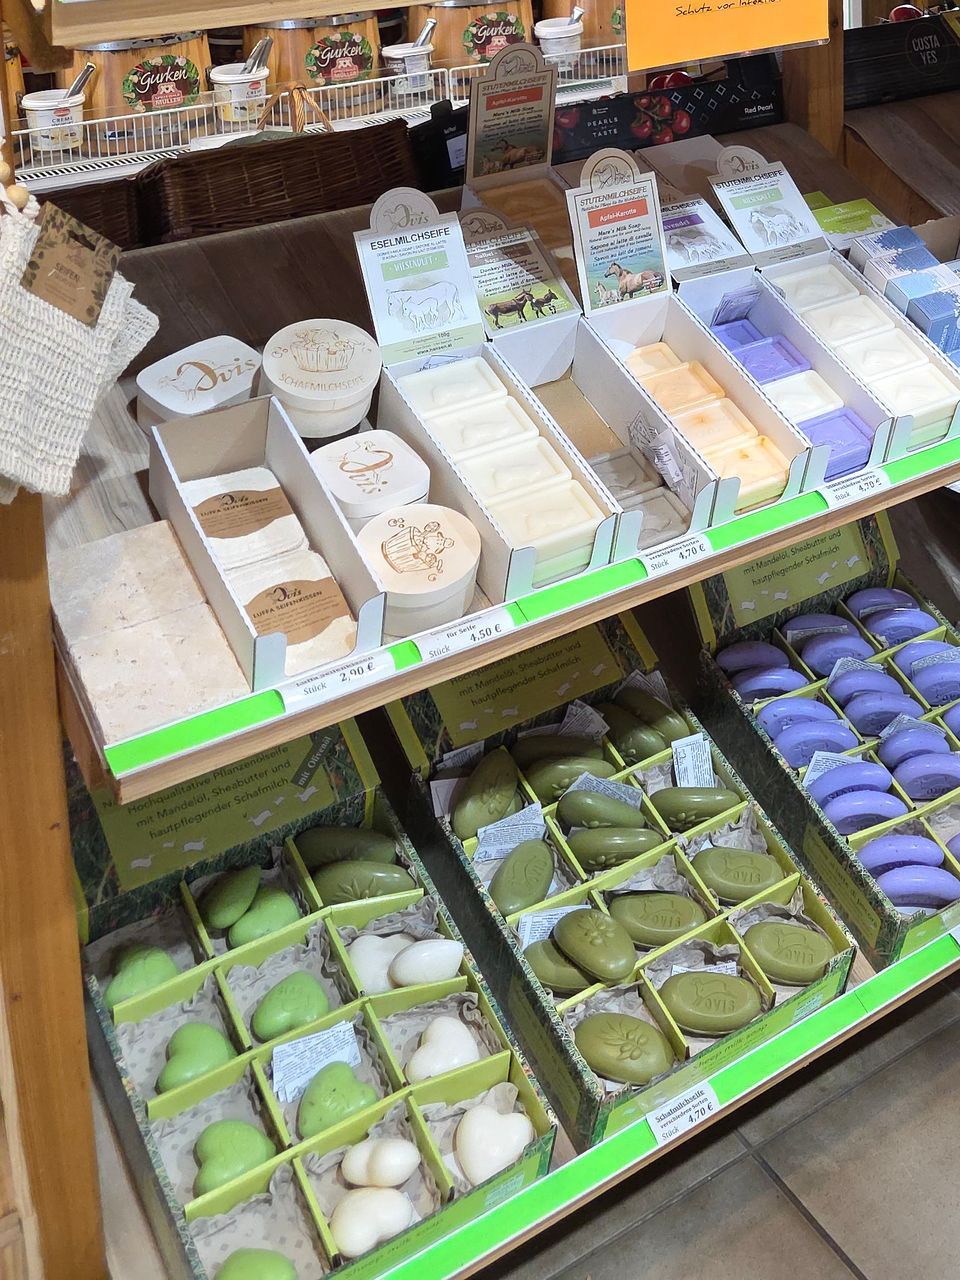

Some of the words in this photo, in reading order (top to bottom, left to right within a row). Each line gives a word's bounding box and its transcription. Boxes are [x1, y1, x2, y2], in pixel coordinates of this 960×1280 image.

[675, 5, 712, 17] Schutz
[717, 2, 735, 10] vor
[478, 23, 518, 44] Gurken
[320, 43, 365, 67] Gurken
[920, 50, 938, 64] YES
[139, 66, 189, 94] Gurken
[744, 105, 757, 114] Red
[758, 103, 774, 113] Pearl
[587, 116, 619, 128] PEARLS
[592, 128, 619, 138] TASTE
[715, 169, 785, 190] STUTENMILCHSEIFE
[580, 186, 648, 207] STUTENMILCHSEIFE
[599, 208, 637, 222] Apfel-Karotte
[370, 227, 451, 251] ESELMILCHSEIFE
[598, 227, 614, 237] Mare's
[615, 225, 627, 234] Milk
[628, 223, 642, 232] Soap
[55, 262, 81, 283] SEIFEN
[177, 357, 256, 391] Ovis
[278, 372, 366, 392] SCHAFMILCHSEIFE
[835, 491, 850, 501] Stück
[858, 480, 874, 492] 4,70
[876, 478, 882, 486] €
[200, 508, 221, 517] LUFFA
[223, 497, 269, 513] SEIFENKISSEN
[649, 544, 681, 561] verschiedene
[682, 538, 699, 549] Sorten
[650, 560, 669, 571] Stück
[678, 546, 698, 561] 4,70
[699, 543, 706, 552] €
[743, 564, 755, 575] mit
[756, 553, 788, 570] Mandelöl,
[791, 535, 827, 556] Sheabutter
[829, 530, 841, 540] und
[752, 560, 803, 586] hautpflegender
[805, 545, 840, 565] Schafmilch
[253, 608, 275, 619] LUFFA
[276, 591, 323, 611] SEIFENKISSEN
[273, 586, 302, 602] Ovis
[429, 645, 450, 658] Stück
[470, 627, 492, 643] 4,50
[494, 624, 502, 633] €
[446, 630, 457, 639] für
[459, 623, 477, 634] Seife
[303, 681, 327, 696] Stück
[339, 667, 364, 683] 2,90
[367, 662, 375, 671] €
[459, 686, 474, 697] mit
[475, 669, 518, 690] Mandelöl,
[519, 649, 563, 671] Sheabutter
[565, 642, 582, 653] und
[471, 675, 536, 707] hautpflegender
[537, 656, 582, 680] Schafmilch
[299, 769, 309, 786] mit
[308, 735, 331, 769] Olivenöl
[127, 778, 211, 815] Hochqualitative
[213, 746, 289, 781] Pflanzenölseife
[136, 815, 155, 828] mit
[157, 795, 209, 820] Mandelöl,
[211, 769, 269, 797] Sheabutter
[271, 760, 291, 774] und
[150, 801, 232, 839] hautpflegender
[235, 777, 289, 805] Schafmilch
[733, 870, 761, 883] OVIS
[786, 947, 814, 964] OVIS
[704, 997, 735, 1010] OVIS
[655, 1089, 705, 1124] Schafmilchseife
[660, 1109, 691, 1129] verschiedene
[692, 1097, 709, 1110] Sorten
[661, 1126, 680, 1141] Stück
[687, 1107, 706, 1125] 4,70
[707, 1101, 714, 1112] €
